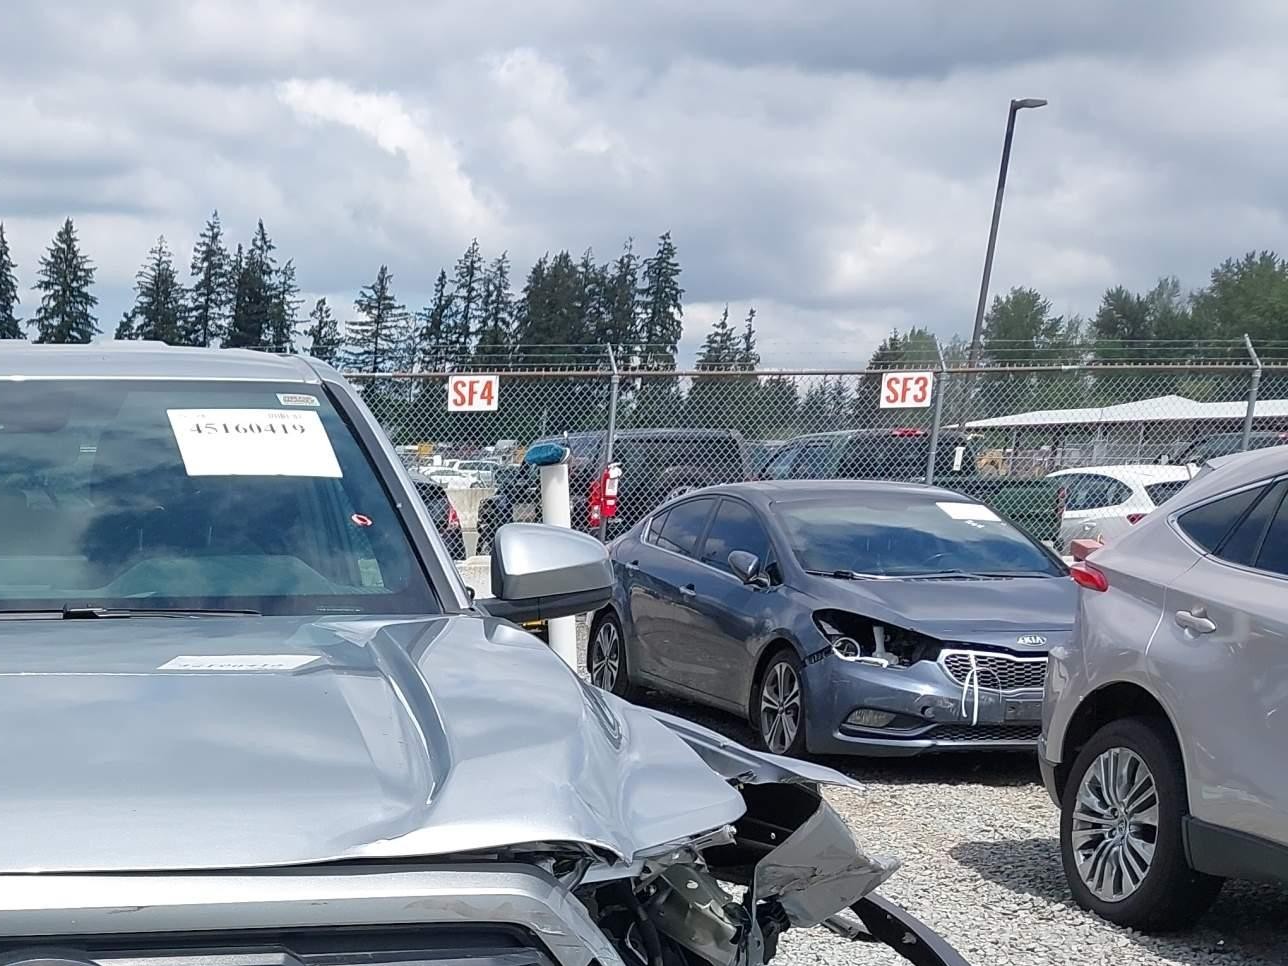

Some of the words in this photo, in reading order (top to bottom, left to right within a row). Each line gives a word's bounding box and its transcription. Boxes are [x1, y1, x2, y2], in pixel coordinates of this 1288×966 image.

[452, 380, 495, 407] SF4
[885, 376, 929, 404] SF3
[189, 422, 307, 435] 45160419
